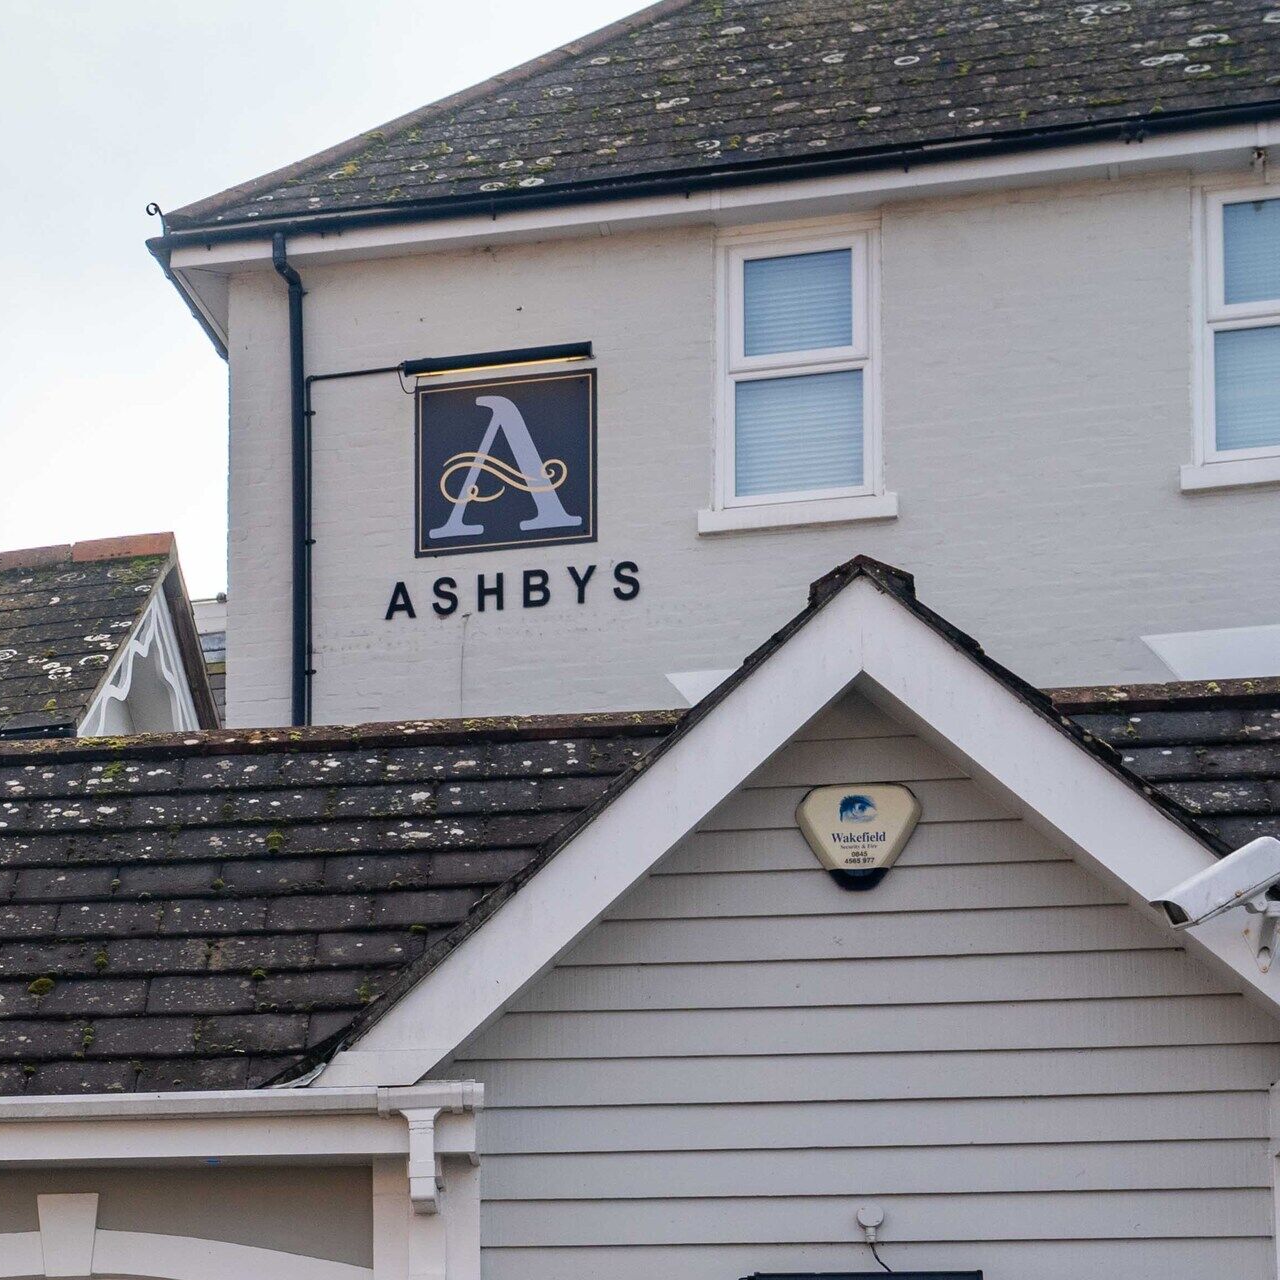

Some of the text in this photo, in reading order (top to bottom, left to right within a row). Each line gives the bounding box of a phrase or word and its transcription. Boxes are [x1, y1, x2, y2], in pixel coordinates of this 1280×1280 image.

[429, 395, 582, 540] A
[385, 561, 640, 620] ASHBYS
[832, 832, 886, 843] Wakefield
